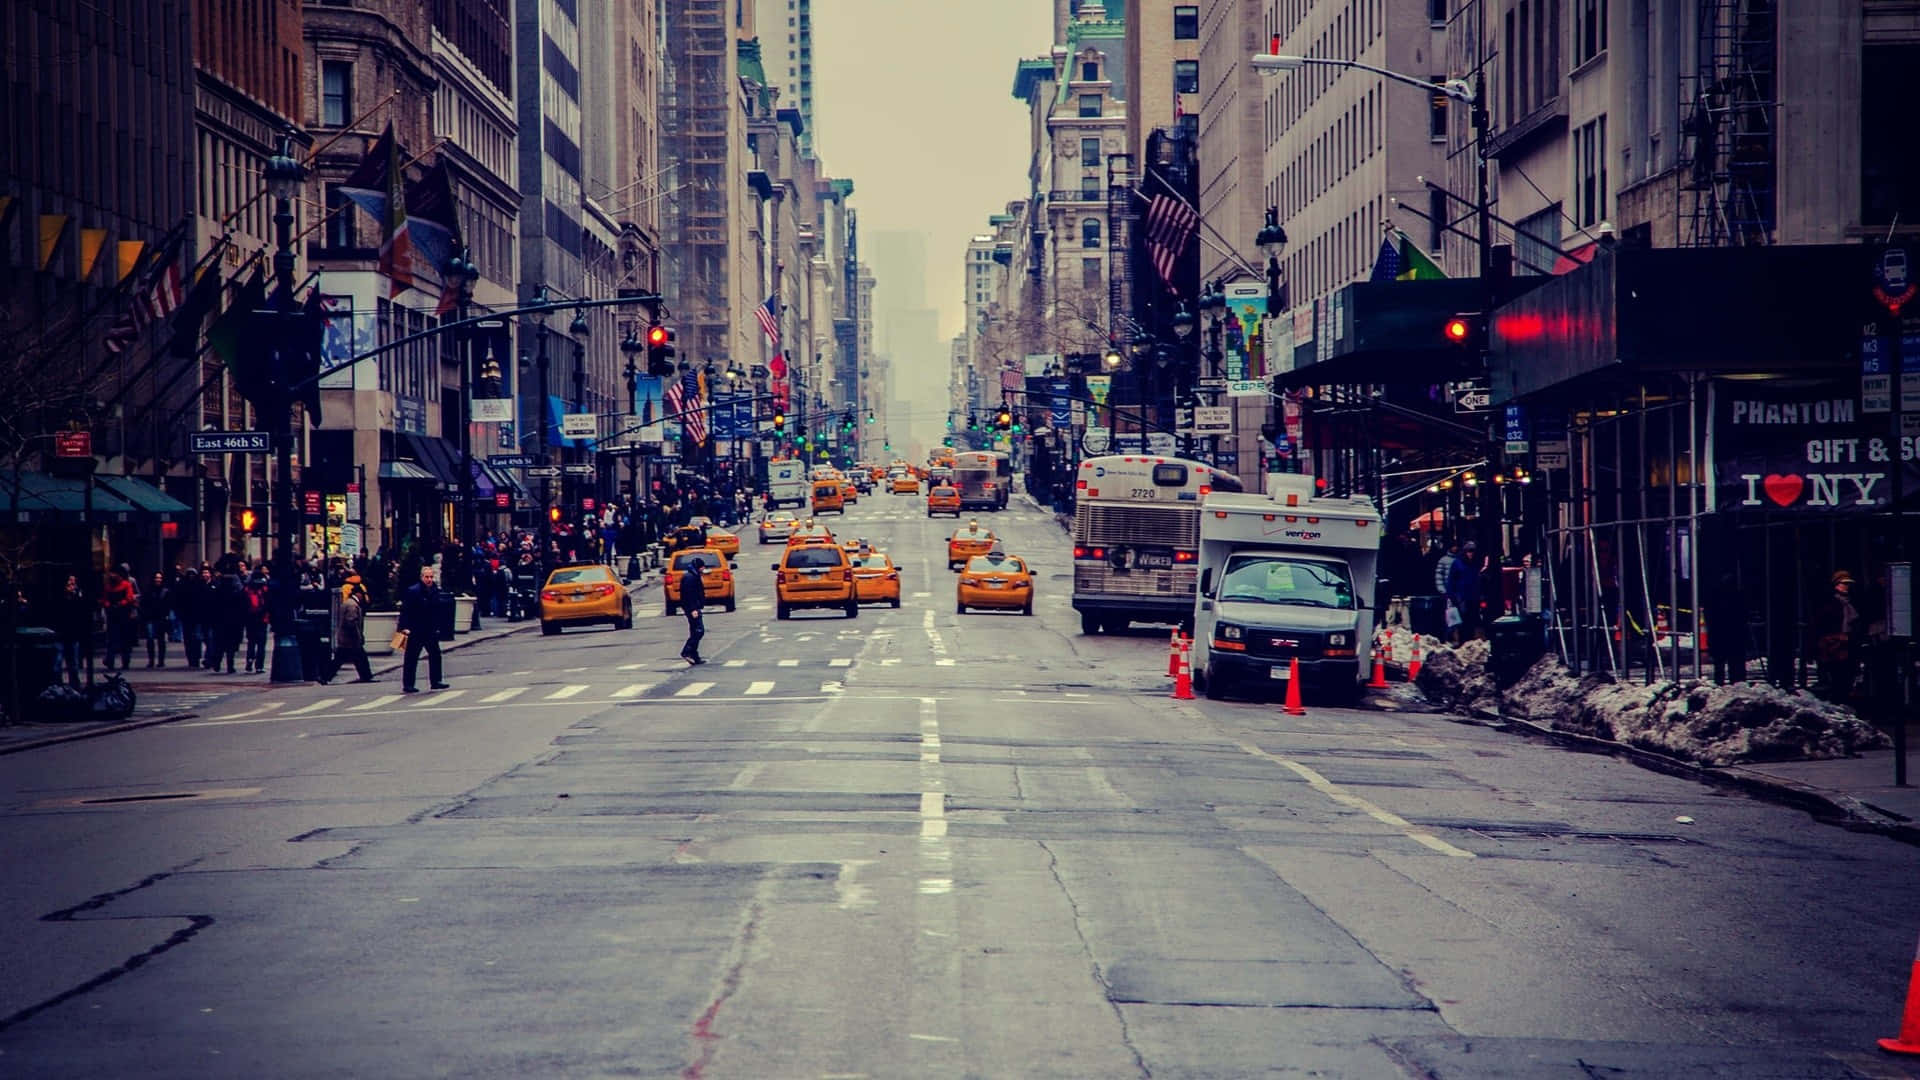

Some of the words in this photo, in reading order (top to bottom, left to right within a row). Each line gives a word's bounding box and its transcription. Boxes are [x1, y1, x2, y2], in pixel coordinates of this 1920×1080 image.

[1864, 339, 1878, 353] M3
[1864, 358, 1879, 372] M5
[1465, 396, 1485, 405] ONE
[1732, 400, 1855, 424] PHANTOM
[196, 437, 221, 448] East
[223, 437, 249, 448] 46th
[251, 436, 264, 447] St
[1806, 440, 1858, 463] GIFT
[1867, 437, 1890, 462] &
[1131, 488, 1155, 498] 2720
[1741, 474, 1762, 505] I
[1286, 530, 1321, 540] verizon
